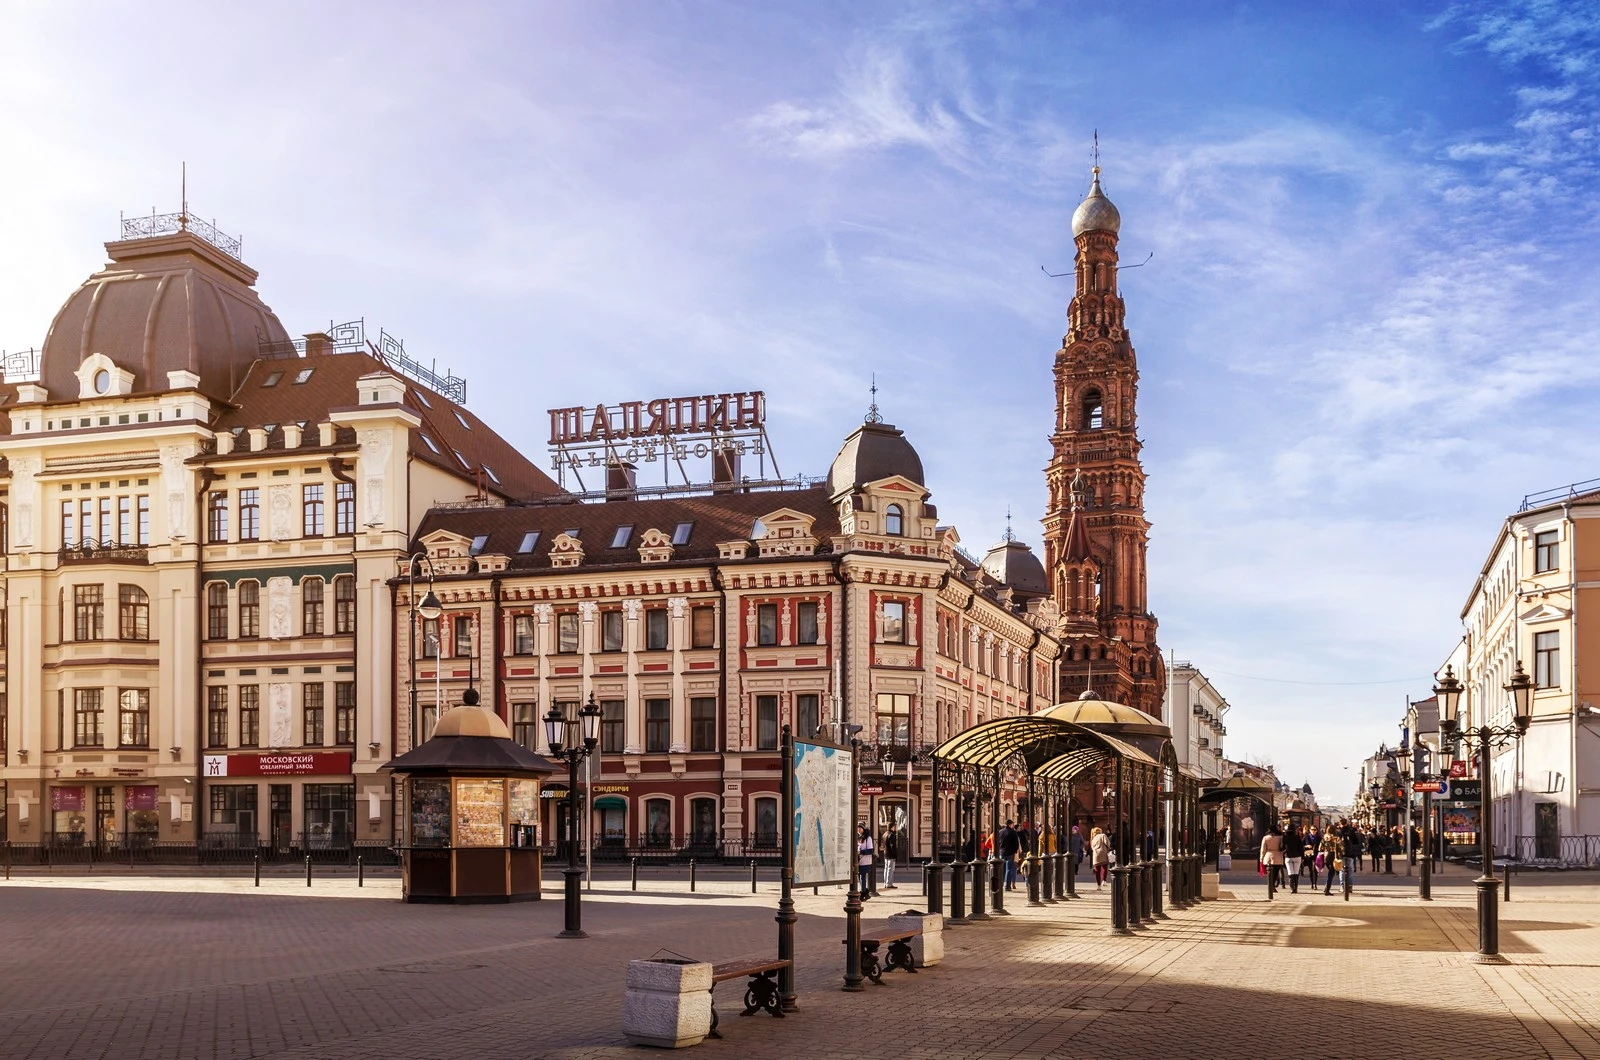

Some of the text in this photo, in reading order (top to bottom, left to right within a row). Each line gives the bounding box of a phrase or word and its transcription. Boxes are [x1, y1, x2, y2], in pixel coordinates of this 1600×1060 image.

[547, 391, 765, 445] ШАЛЯПИН
[551, 439, 765, 470] PALACE HOTEL
[260, 755, 314, 764] МОСКОВСКИЙ
[539, 790, 570, 798] SUBWAY
